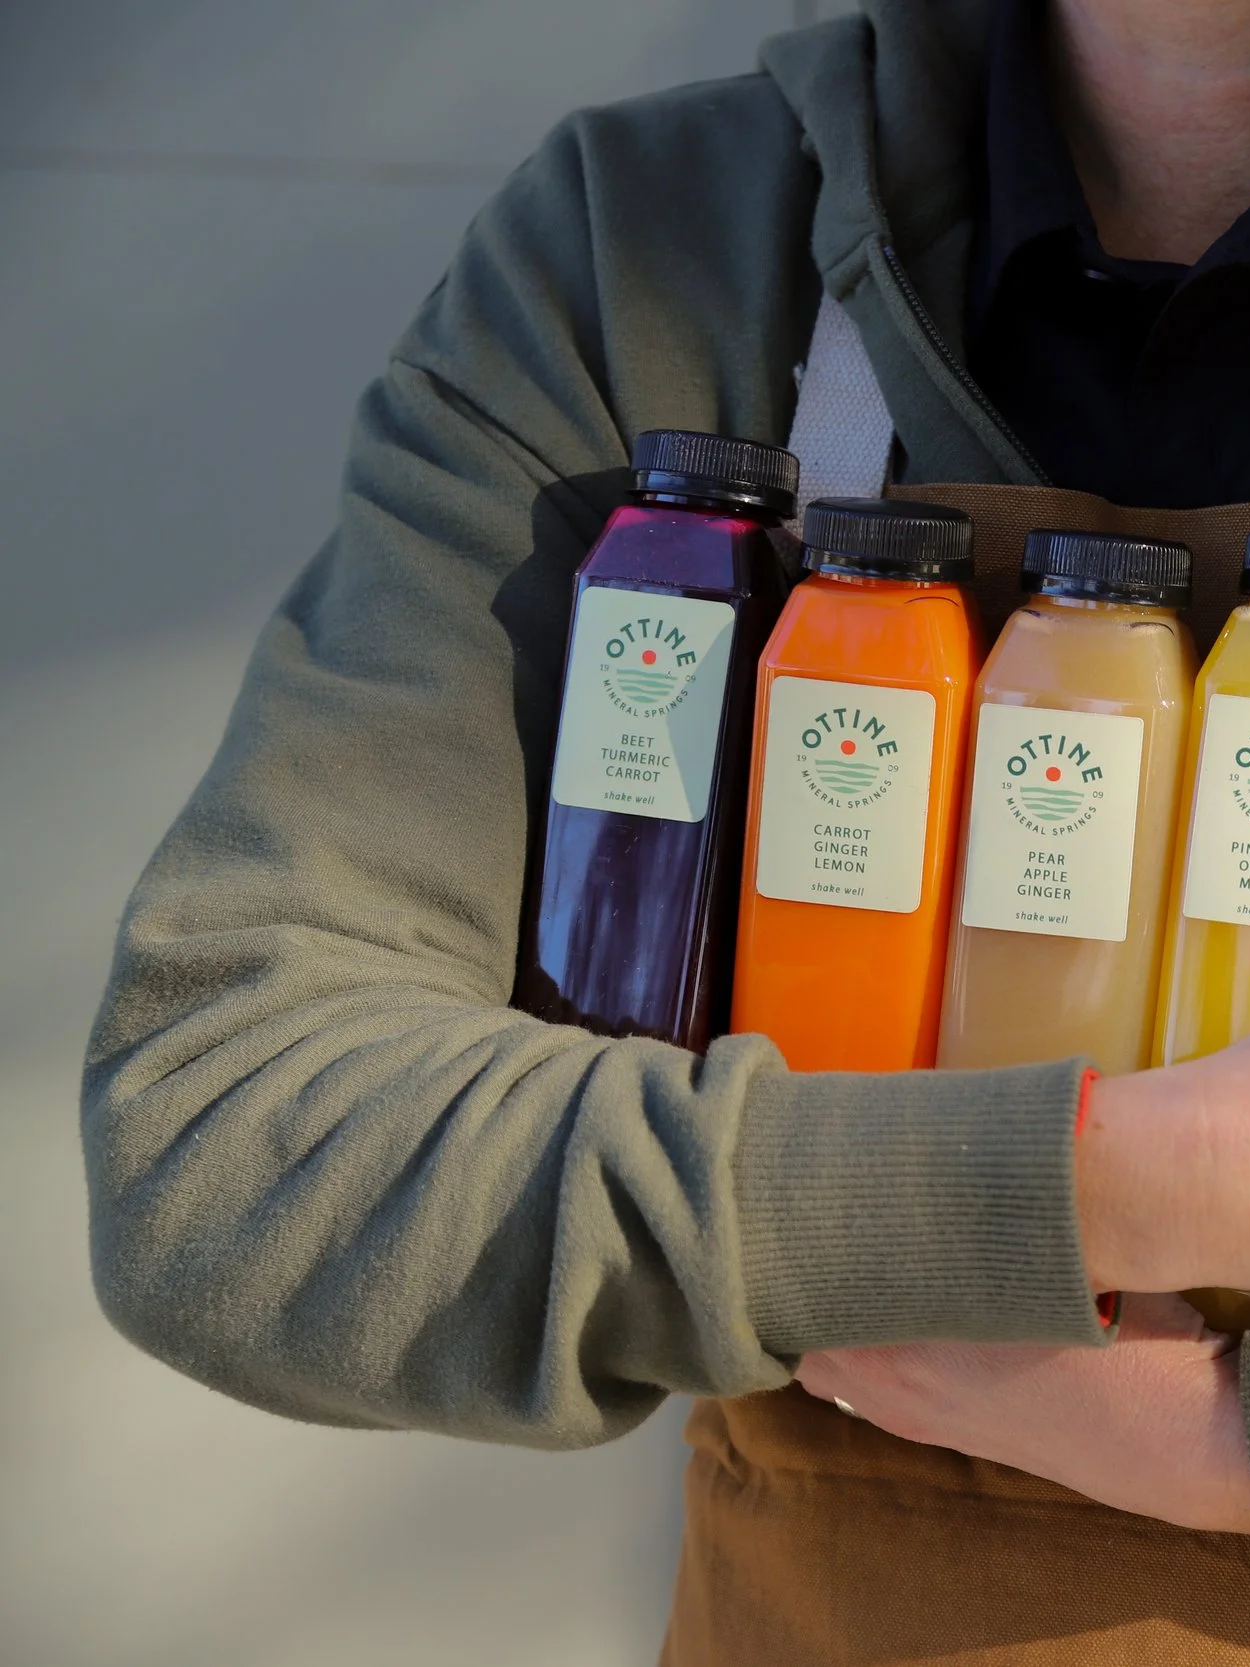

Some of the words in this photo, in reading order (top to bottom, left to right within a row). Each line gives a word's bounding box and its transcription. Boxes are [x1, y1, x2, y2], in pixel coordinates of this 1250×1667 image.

[606, 618, 696, 667] OTTINE
[600, 664, 609, 672] 19
[686, 674, 696, 682] 09
[603, 679, 638, 717] MINERAL
[644, 689, 688, 718] SPRINGS
[802, 708, 898, 757] OTTINE
[621, 734, 655, 748] BEET
[601, 748, 670, 767] TURMERIC
[1007, 734, 1103, 783] OTTINE
[606, 766, 661, 782] CARROT
[801, 770, 840, 807] MINERAL
[848, 780, 892, 809] SPRINGS
[1093, 791, 1103, 799] 09
[604, 791, 632, 803] shake
[635, 793, 655, 805] well
[1006, 797, 1045, 835] MINERAL
[1052, 806, 1096, 836] SPRINGS
[814, 824, 871, 841] CARROT
[814, 841, 868, 857] GINGER
[815, 858, 865, 873] LEMON
[1029, 851, 1065, 865] PEAR
[1024, 868, 1067, 883] APPLE
[812, 882, 840, 894] shake
[844, 885, 864, 896] well
[1017, 884, 1071, 900] GINGER
[1015, 911, 1044, 922] shake
[1048, 913, 1068, 924] well
